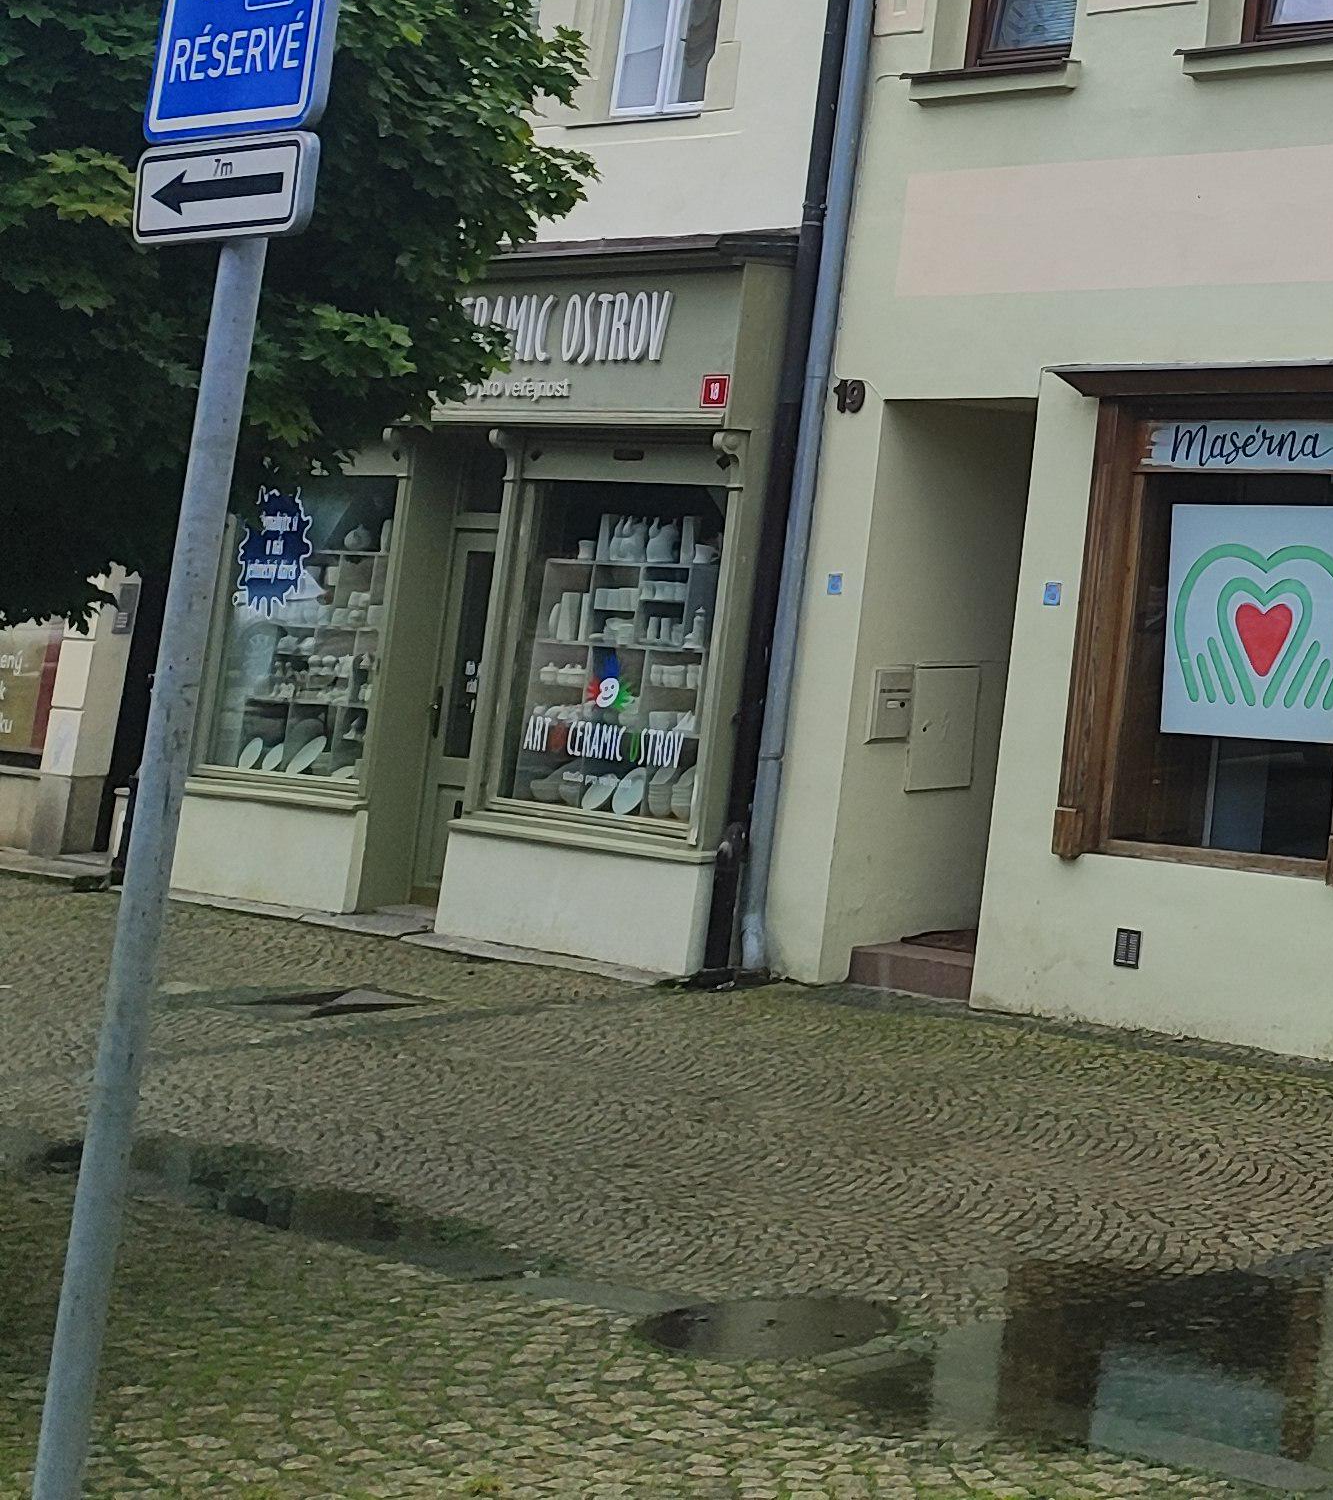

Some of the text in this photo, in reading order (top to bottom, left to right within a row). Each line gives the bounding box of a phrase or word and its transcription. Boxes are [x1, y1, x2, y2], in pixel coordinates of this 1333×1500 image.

[168, 11, 304, 84] RÉSERVÉ
[213, 159, 233, 177] 7m
[562, 290, 674, 364] OSTROV
[833, 379, 865, 414] 19
[523, 714, 551, 751] ART
[566, 719, 627, 761] CERAMIC
[629, 727, 684, 769] OSTROV
